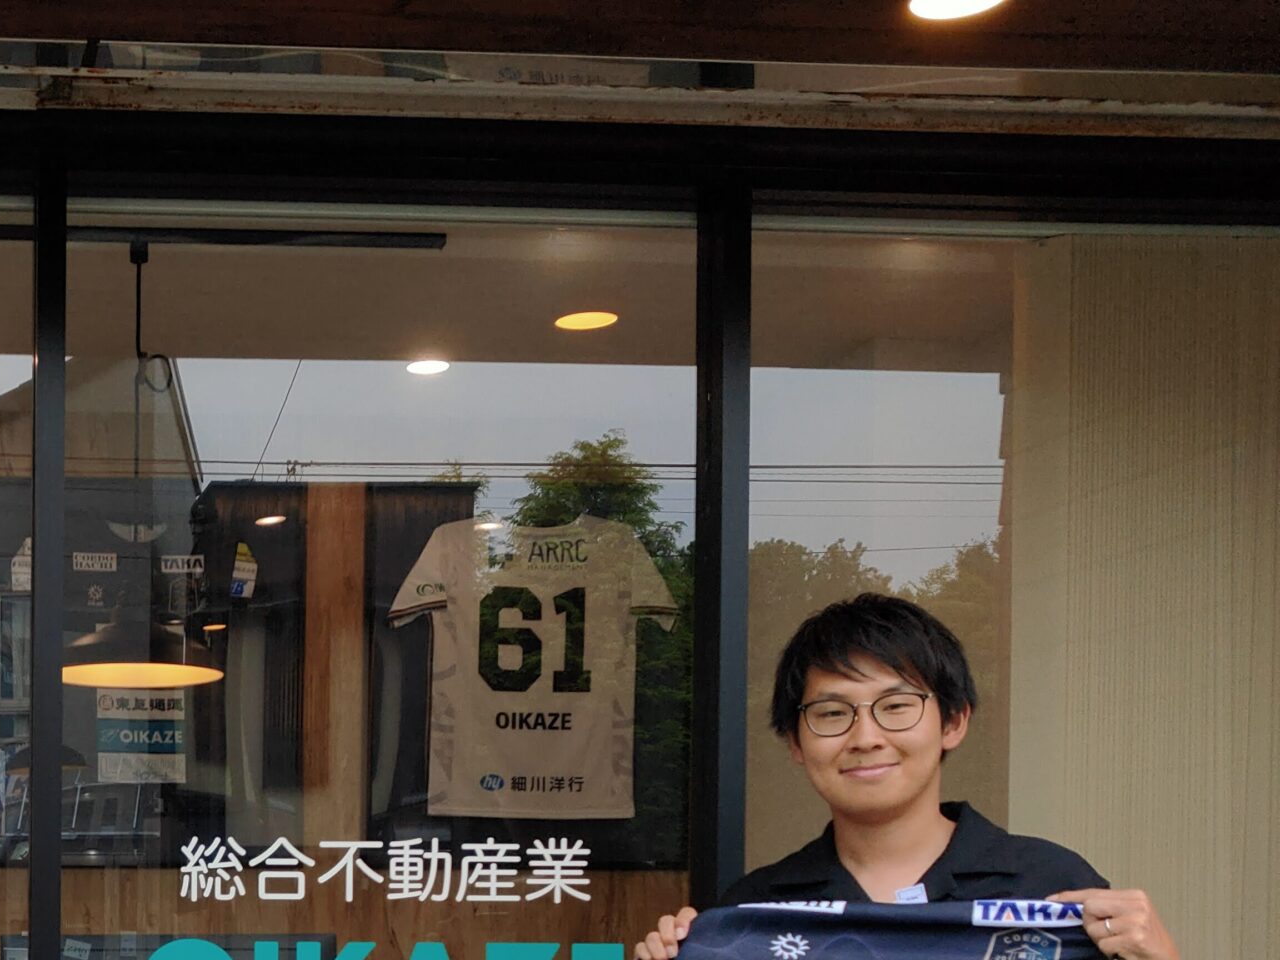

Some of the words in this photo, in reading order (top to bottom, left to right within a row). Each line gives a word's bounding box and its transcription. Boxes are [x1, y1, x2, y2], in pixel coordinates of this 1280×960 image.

[163, 558, 203, 570] TAKA
[478, 586, 591, 692] 61
[495, 712, 572, 731] OIKAZE
[119, 728, 183, 744] OIKAZE
[510, 775, 585, 793] 細川洋行
[179, 836, 591, 903] 総合不動産業
[976, 901, 1083, 922] TAKA
